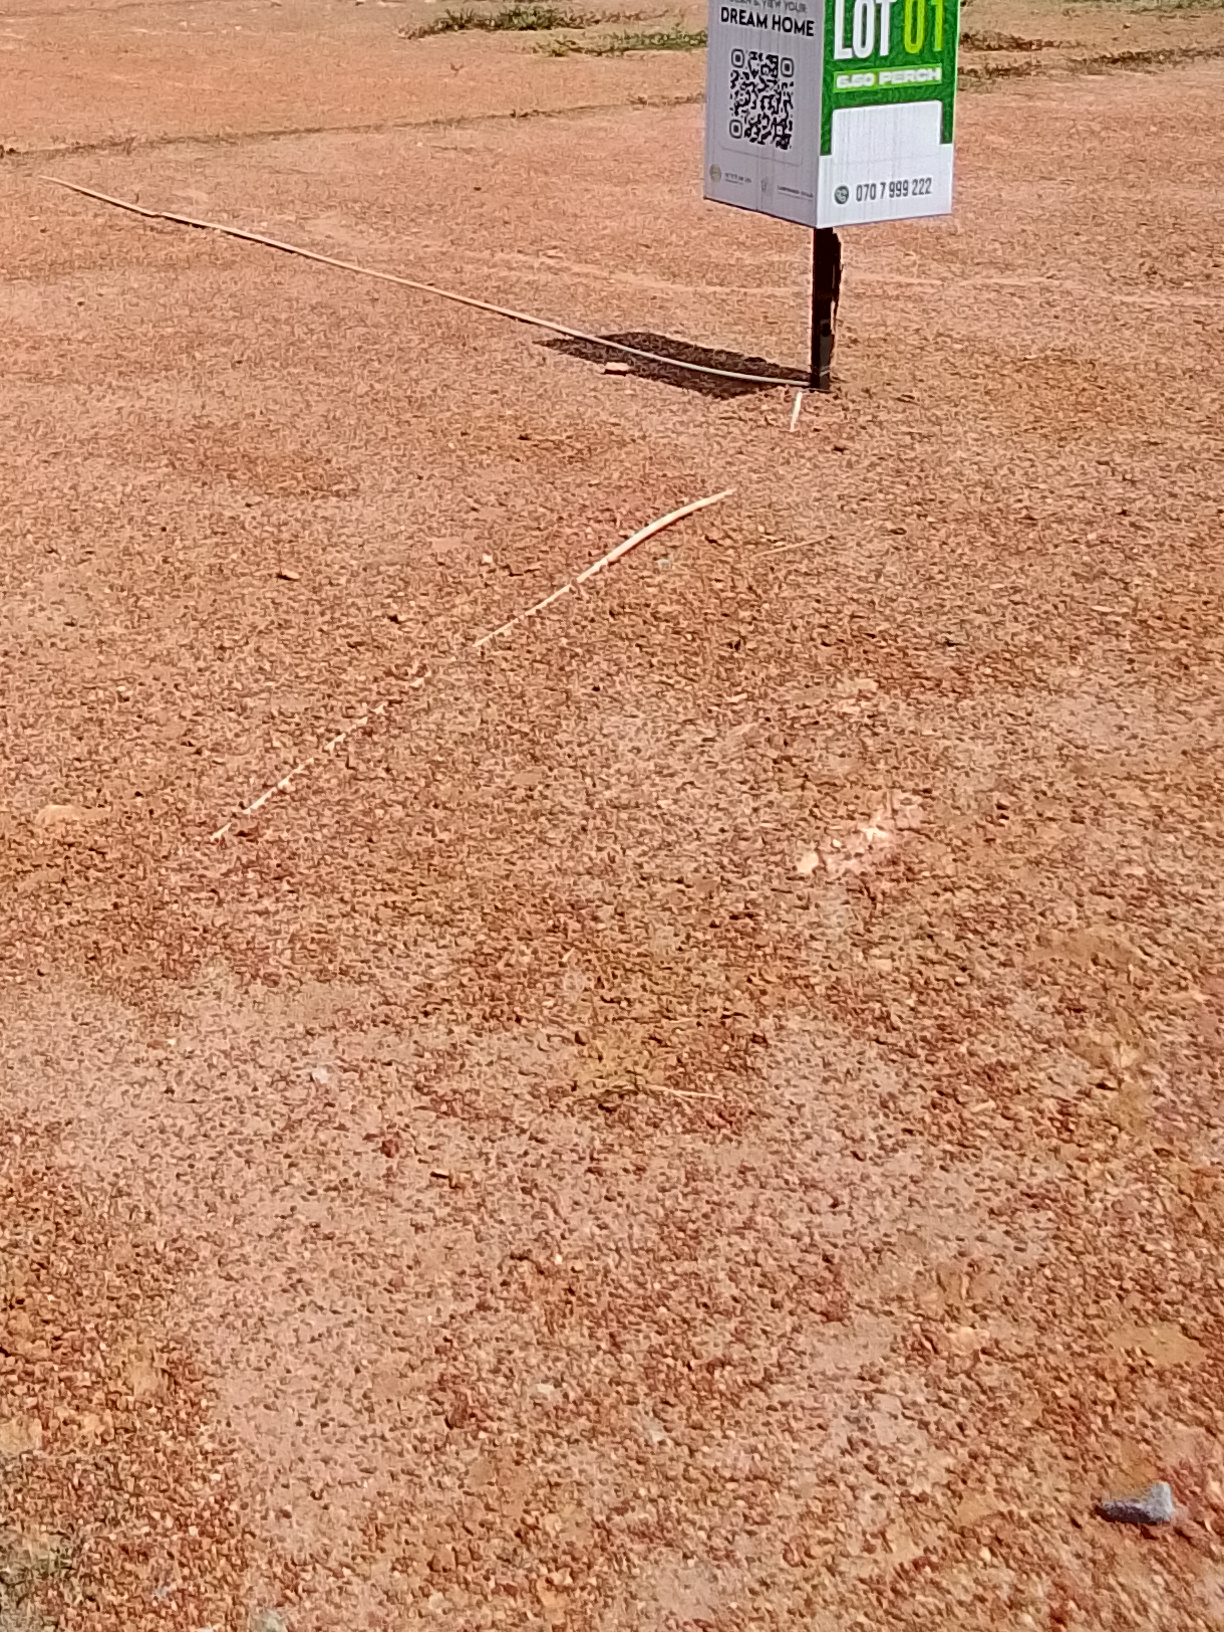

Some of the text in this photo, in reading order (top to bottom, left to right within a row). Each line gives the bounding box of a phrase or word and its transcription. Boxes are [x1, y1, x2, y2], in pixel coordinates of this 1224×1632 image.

[720, 6, 816, 37] DREAM HOME
[878, 67, 943, 85] PERCH
[855, 177, 933, 202] 070 7 999 222
